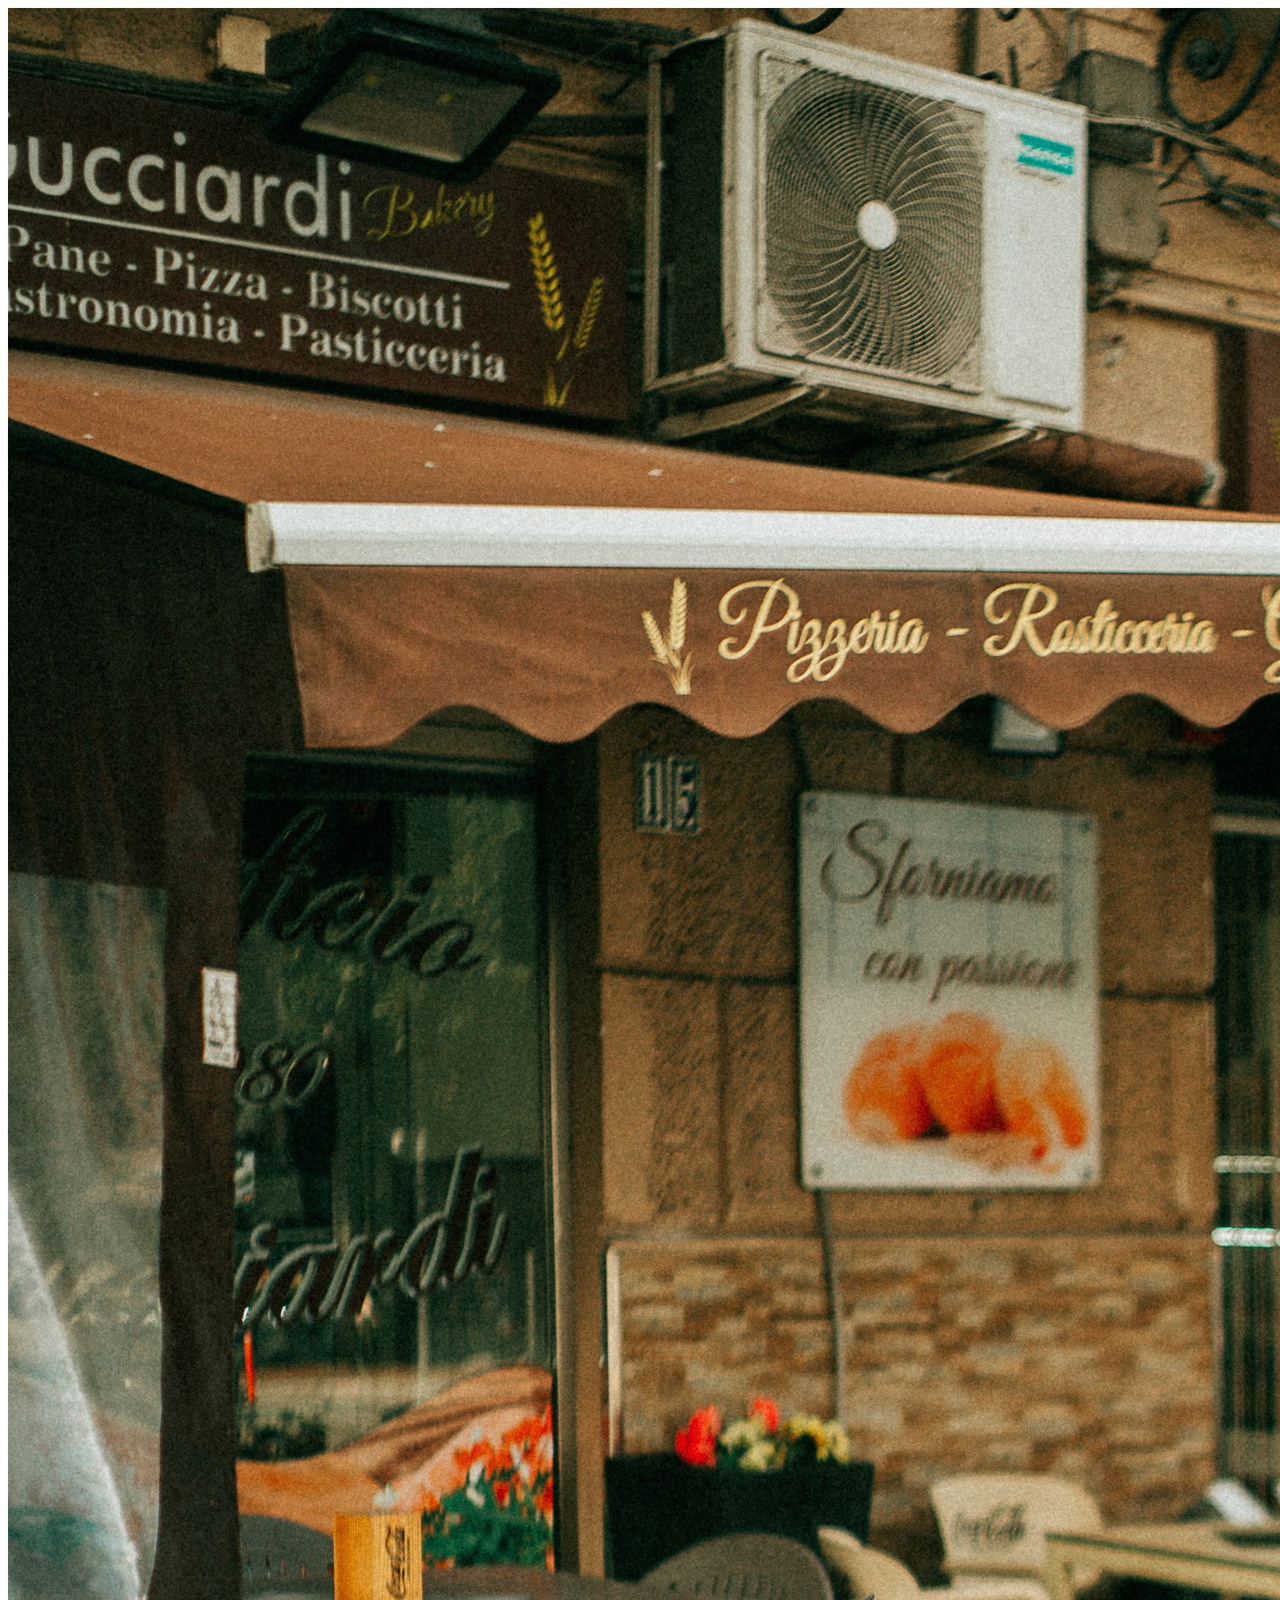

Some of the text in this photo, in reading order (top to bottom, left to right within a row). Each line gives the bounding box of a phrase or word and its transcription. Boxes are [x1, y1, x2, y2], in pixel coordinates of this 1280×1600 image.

[8, 224, 463, 331] Pane Pizza Biscotti
[8, 282, 506, 383] stronomia Pasticceria
[717, 577, 931, 683] Pizzeria
[983, 582, 1219, 657] Rosticceria
[819, 818, 1058, 929] Sforniamo
